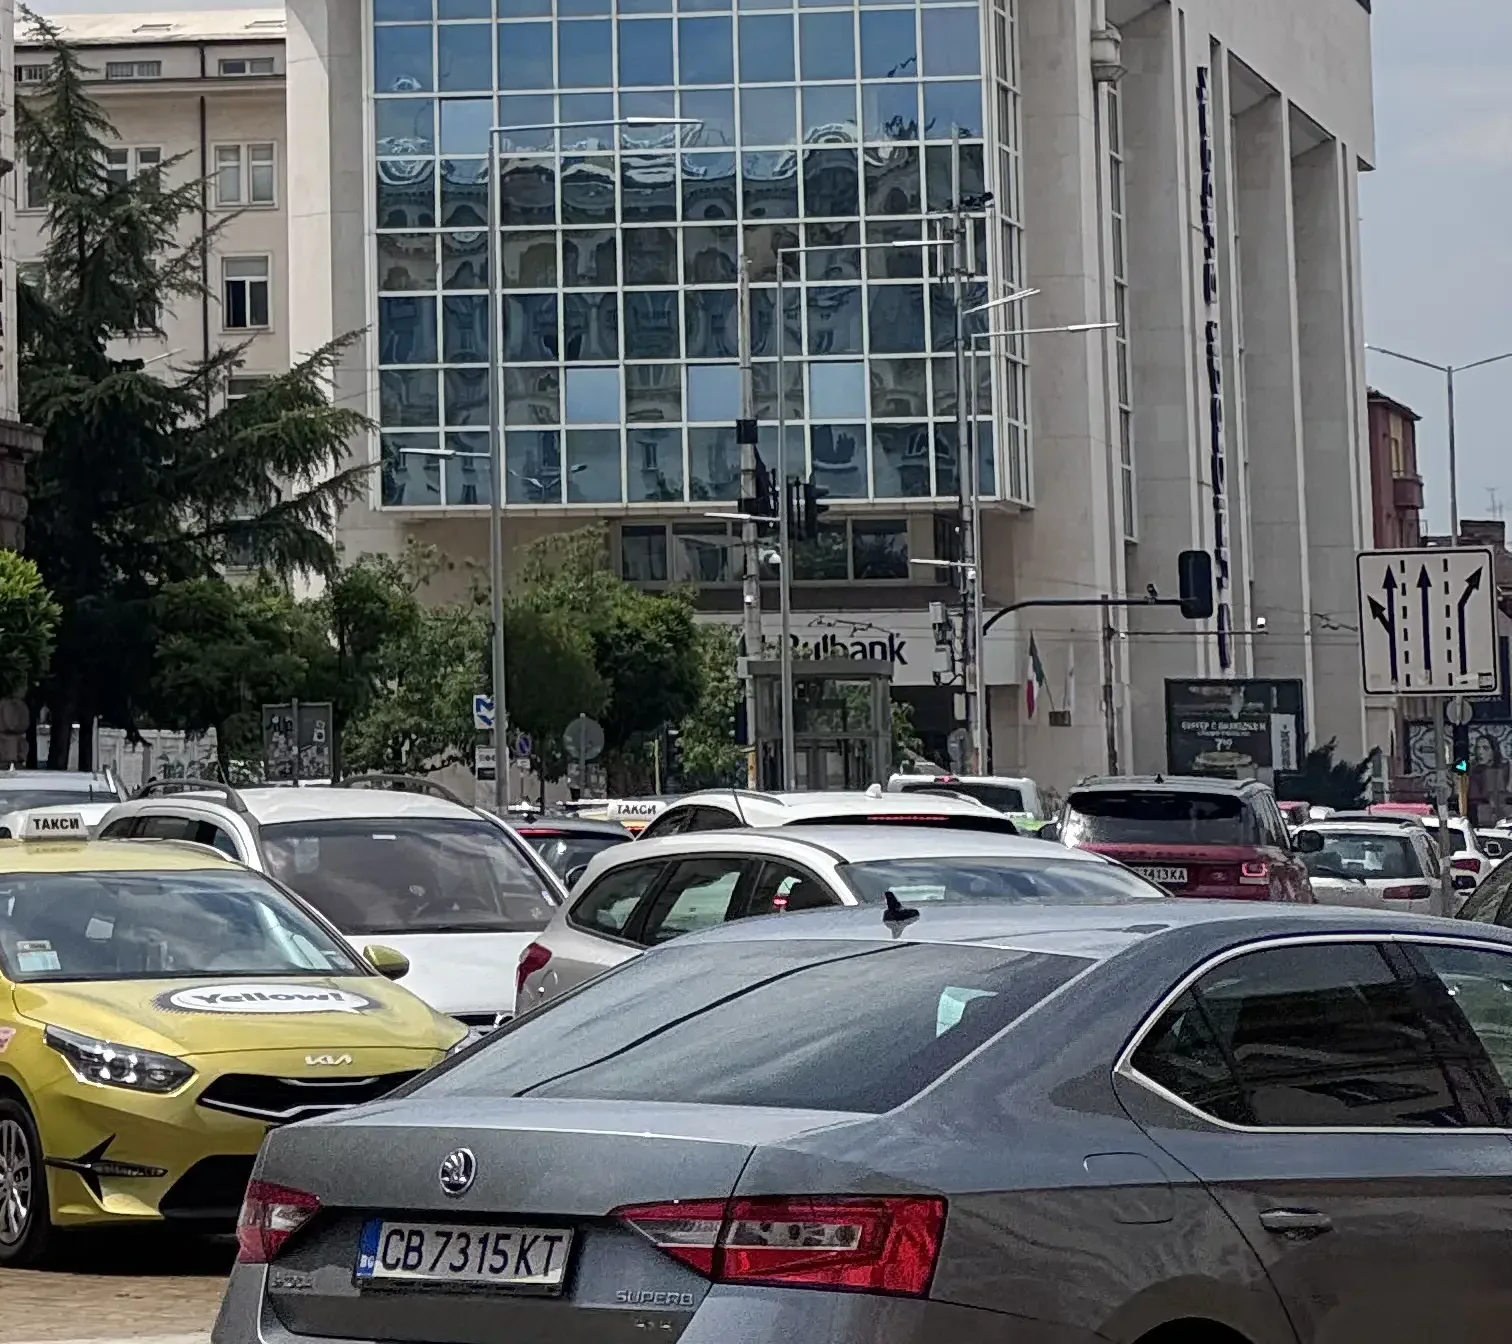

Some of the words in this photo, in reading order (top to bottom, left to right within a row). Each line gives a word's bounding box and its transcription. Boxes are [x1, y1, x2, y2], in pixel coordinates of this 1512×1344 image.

[617, 804, 656, 815] ТАКСИ
[33, 818, 79, 830] ТАКСИ
[191, 992, 346, 1004] Yellow!
[616, 1290, 694, 1307] SUPERB
